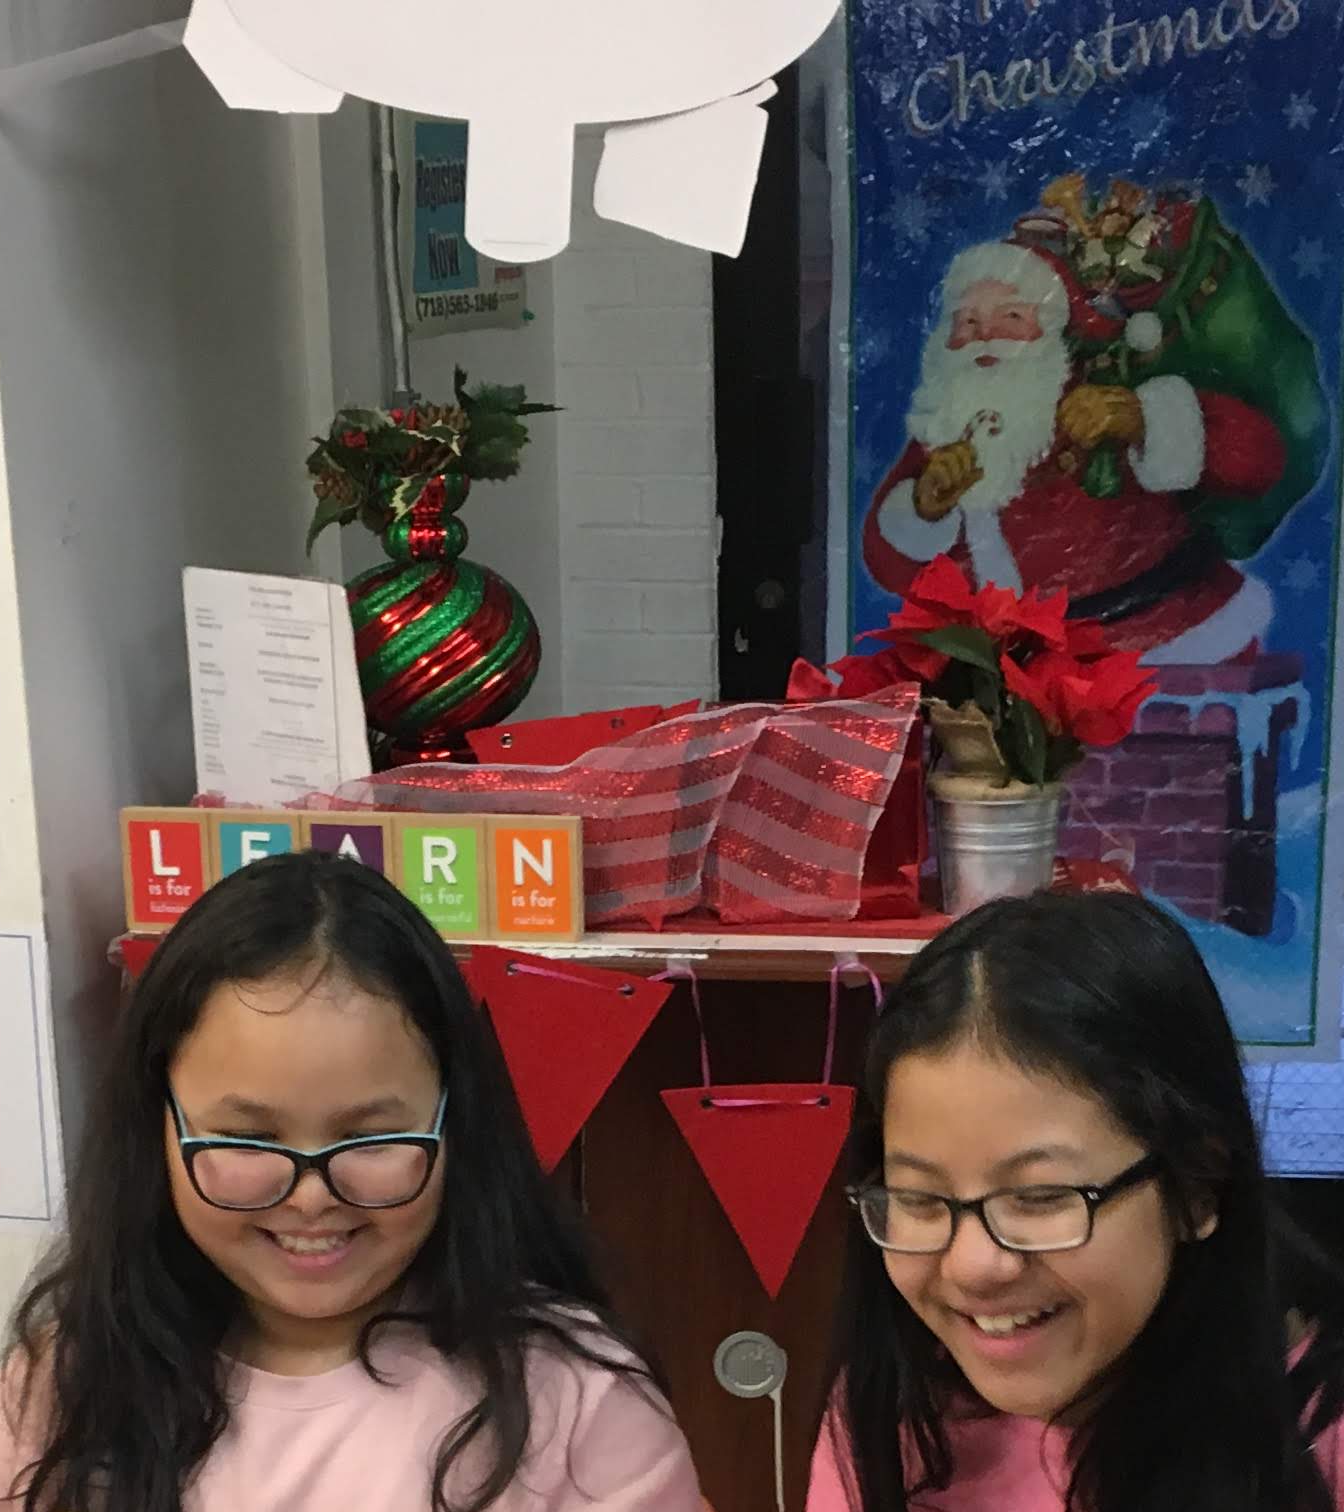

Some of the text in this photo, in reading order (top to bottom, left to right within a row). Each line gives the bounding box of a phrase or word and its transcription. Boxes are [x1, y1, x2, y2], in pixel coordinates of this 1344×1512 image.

[148, 879, 192, 896] is for
[438, 888, 464, 905] for
[511, 890, 556, 907] is for
